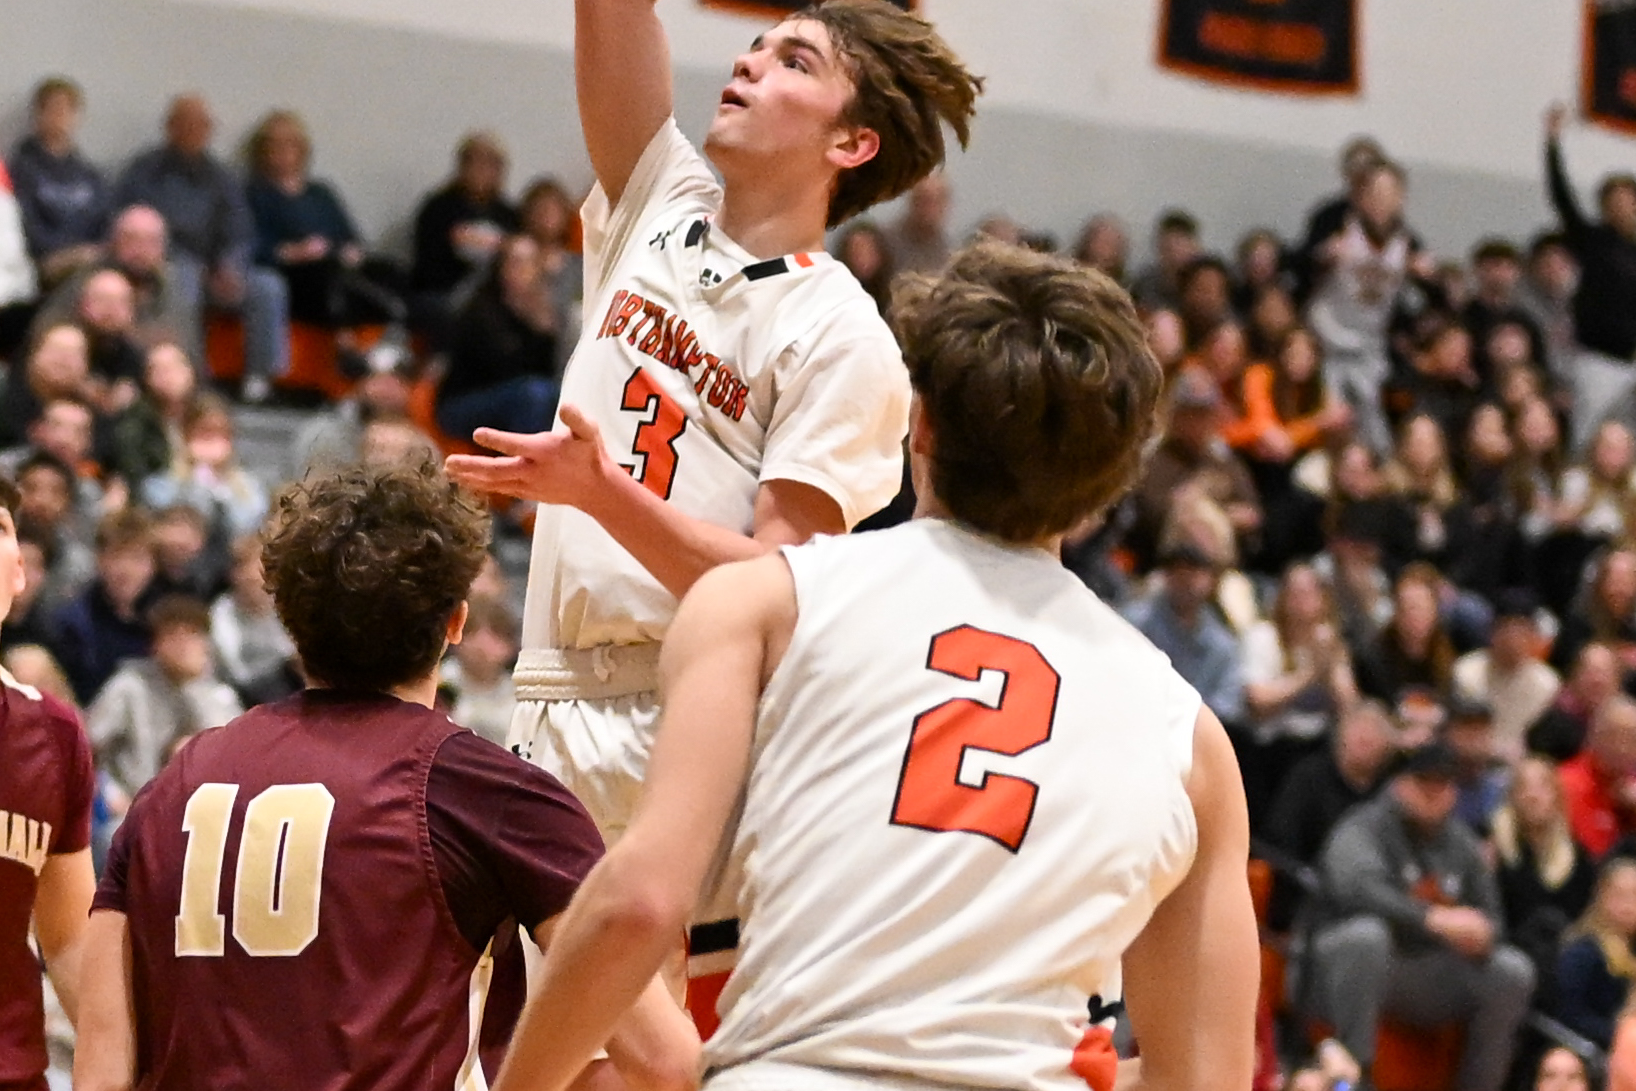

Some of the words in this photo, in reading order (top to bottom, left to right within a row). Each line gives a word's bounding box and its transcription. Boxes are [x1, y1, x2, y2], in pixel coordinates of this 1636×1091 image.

[619, 366, 687, 501] 3
[889, 623, 1061, 854] 2
[175, 782, 335, 957] 10
